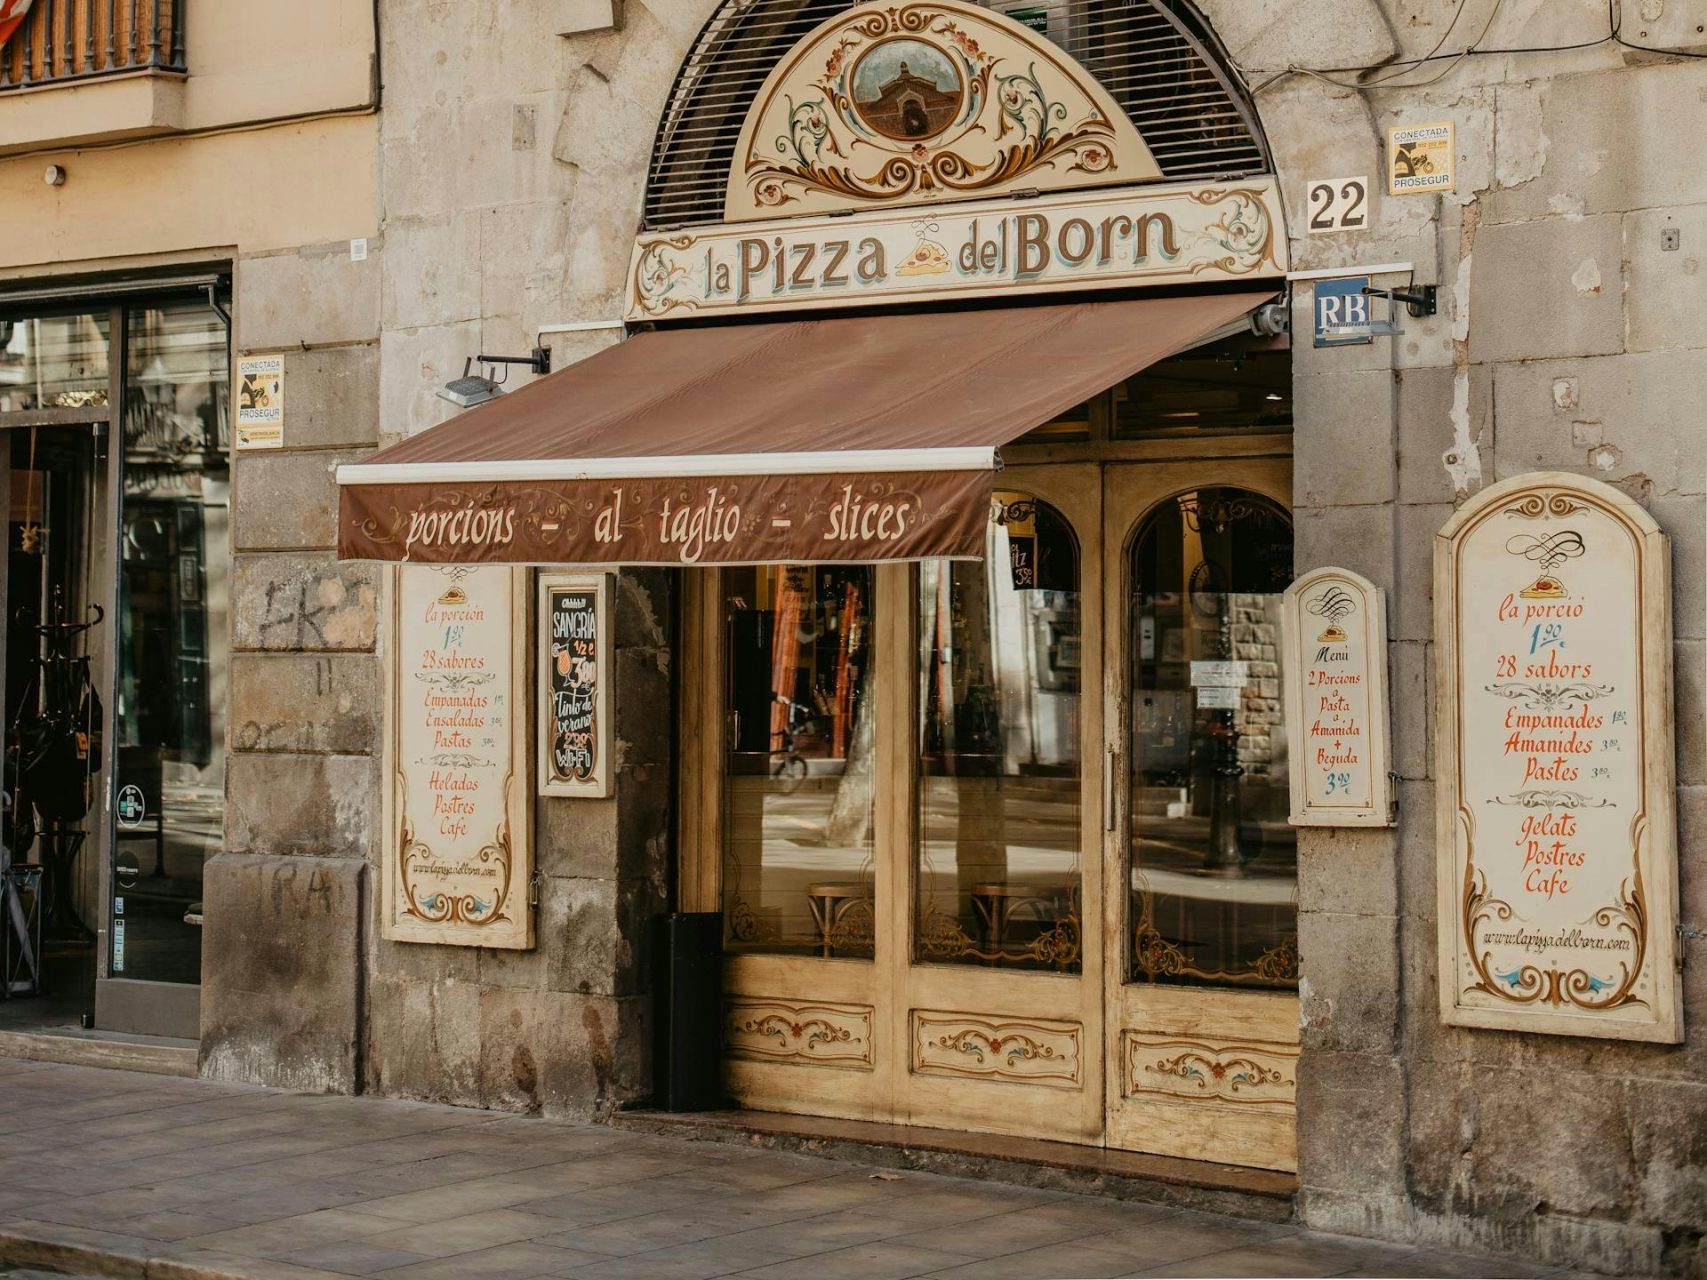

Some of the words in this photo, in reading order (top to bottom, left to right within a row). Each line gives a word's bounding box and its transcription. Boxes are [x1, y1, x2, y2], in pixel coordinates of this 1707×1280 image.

[1394, 127, 1449, 140] CONECTADA
[1394, 174, 1450, 189] PROSEGUR
[1310, 181, 1365, 230] 22
[704, 246, 731, 299] la
[736, 236, 888, 304] Pizza
[957, 217, 1008, 276] del
[1013, 211, 1182, 279] Born
[240, 360, 280, 370] CONECTADA
[239, 408, 280, 419] PROSEGUR
[401, 500, 515, 562] porcions
[594, 487, 624, 543] al
[659, 487, 740, 563] taglio
[824, 484, 910, 541] slices
[425, 601, 437, 623] la
[1498, 593, 1519, 621] la
[553, 607, 596, 639] SANGRÍA
[422, 650, 436, 669] 28
[437, 650, 484, 669] sabores
[1496, 655, 1517, 677] 28
[1525, 649, 1591, 678] sabors
[1308, 670, 1316, 686] 2
[1317, 670, 1361, 690] Porcions
[424, 687, 488, 710] Empanadas
[555, 688, 590, 718] Tinto
[1320, 695, 1350, 714] Pasta
[425, 708, 485, 728] Ensaladas
[558, 713, 593, 734] verano
[1310, 718, 1360, 738] Amanida
[1504, 703, 1603, 735] Empanades
[433, 730, 472, 752] Pastas
[1503, 730, 1593, 757] Amanides
[1317, 746, 1359, 771] Beguda
[1521, 756, 1579, 789] Pastes
[1521, 840, 1585, 873] Postres
